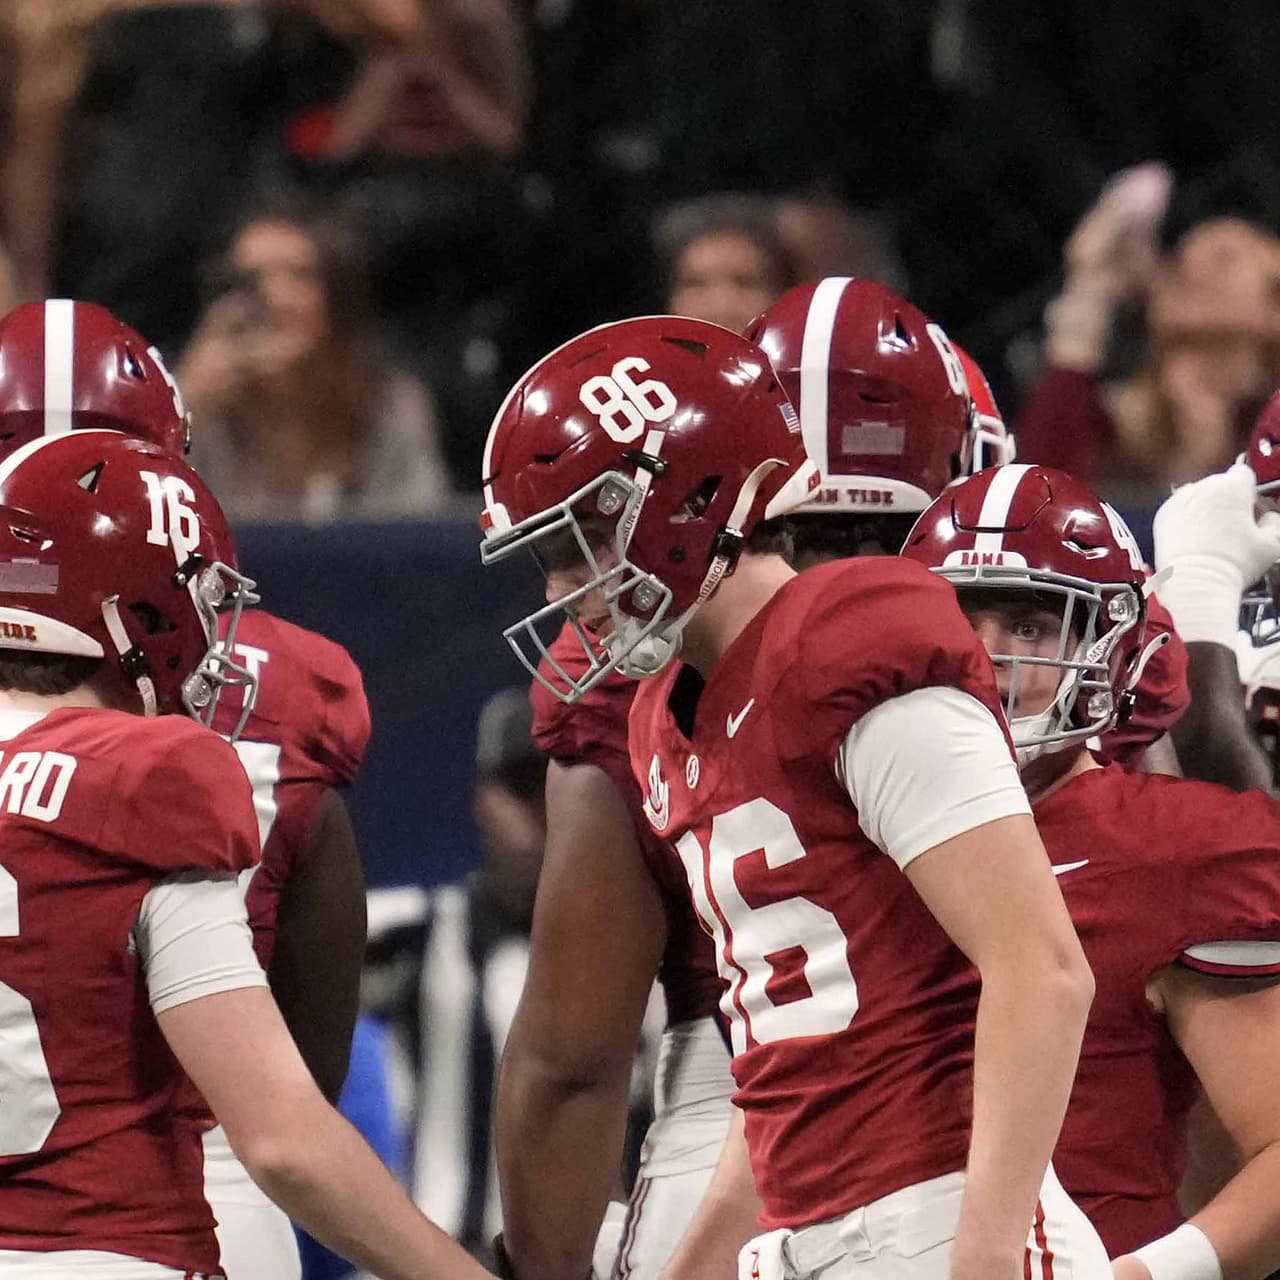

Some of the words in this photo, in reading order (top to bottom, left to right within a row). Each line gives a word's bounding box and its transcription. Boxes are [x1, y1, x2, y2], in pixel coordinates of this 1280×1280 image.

[580, 357, 677, 443] 86
[139, 470, 200, 568] 16
[961, 552, 1005, 567] BAMA
